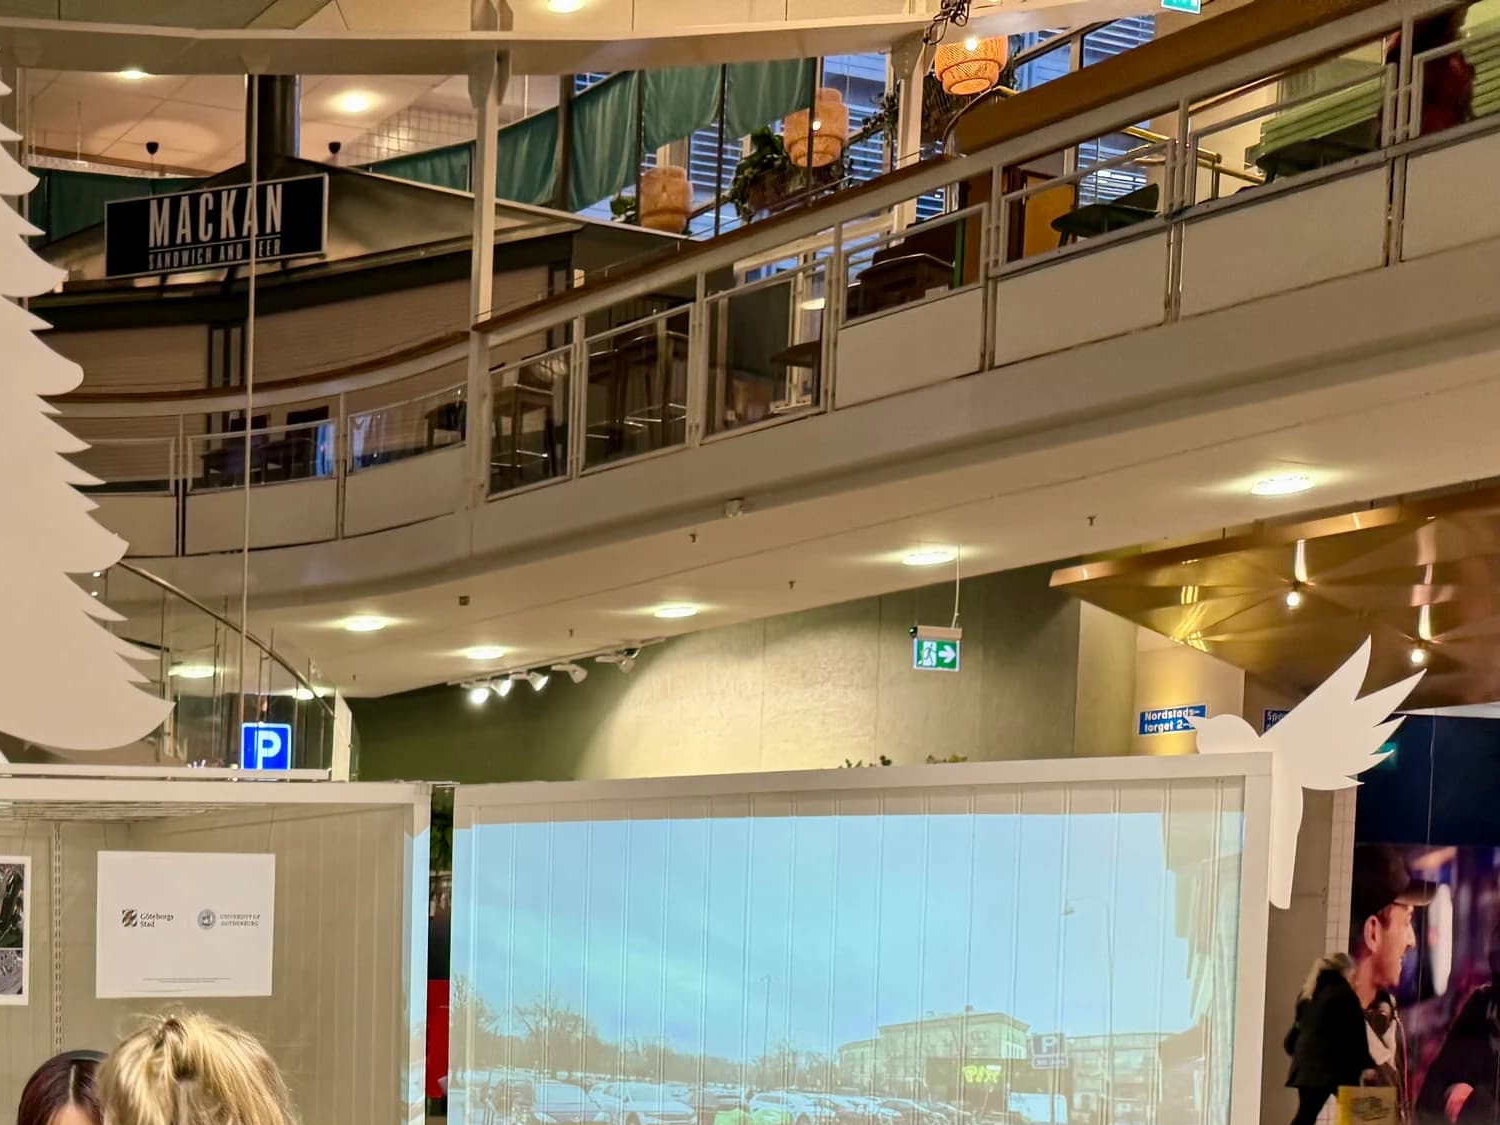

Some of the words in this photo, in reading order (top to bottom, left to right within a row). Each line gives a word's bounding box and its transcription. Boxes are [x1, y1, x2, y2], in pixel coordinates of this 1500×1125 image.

[149, 183, 283, 249] MACKAN
[148, 246, 213, 271] SANDWICH
[219, 243, 243, 262] AND
[255, 239, 281, 258] EER
[1144, 719, 1175, 734] torget
[257, 729, 282, 770] P
